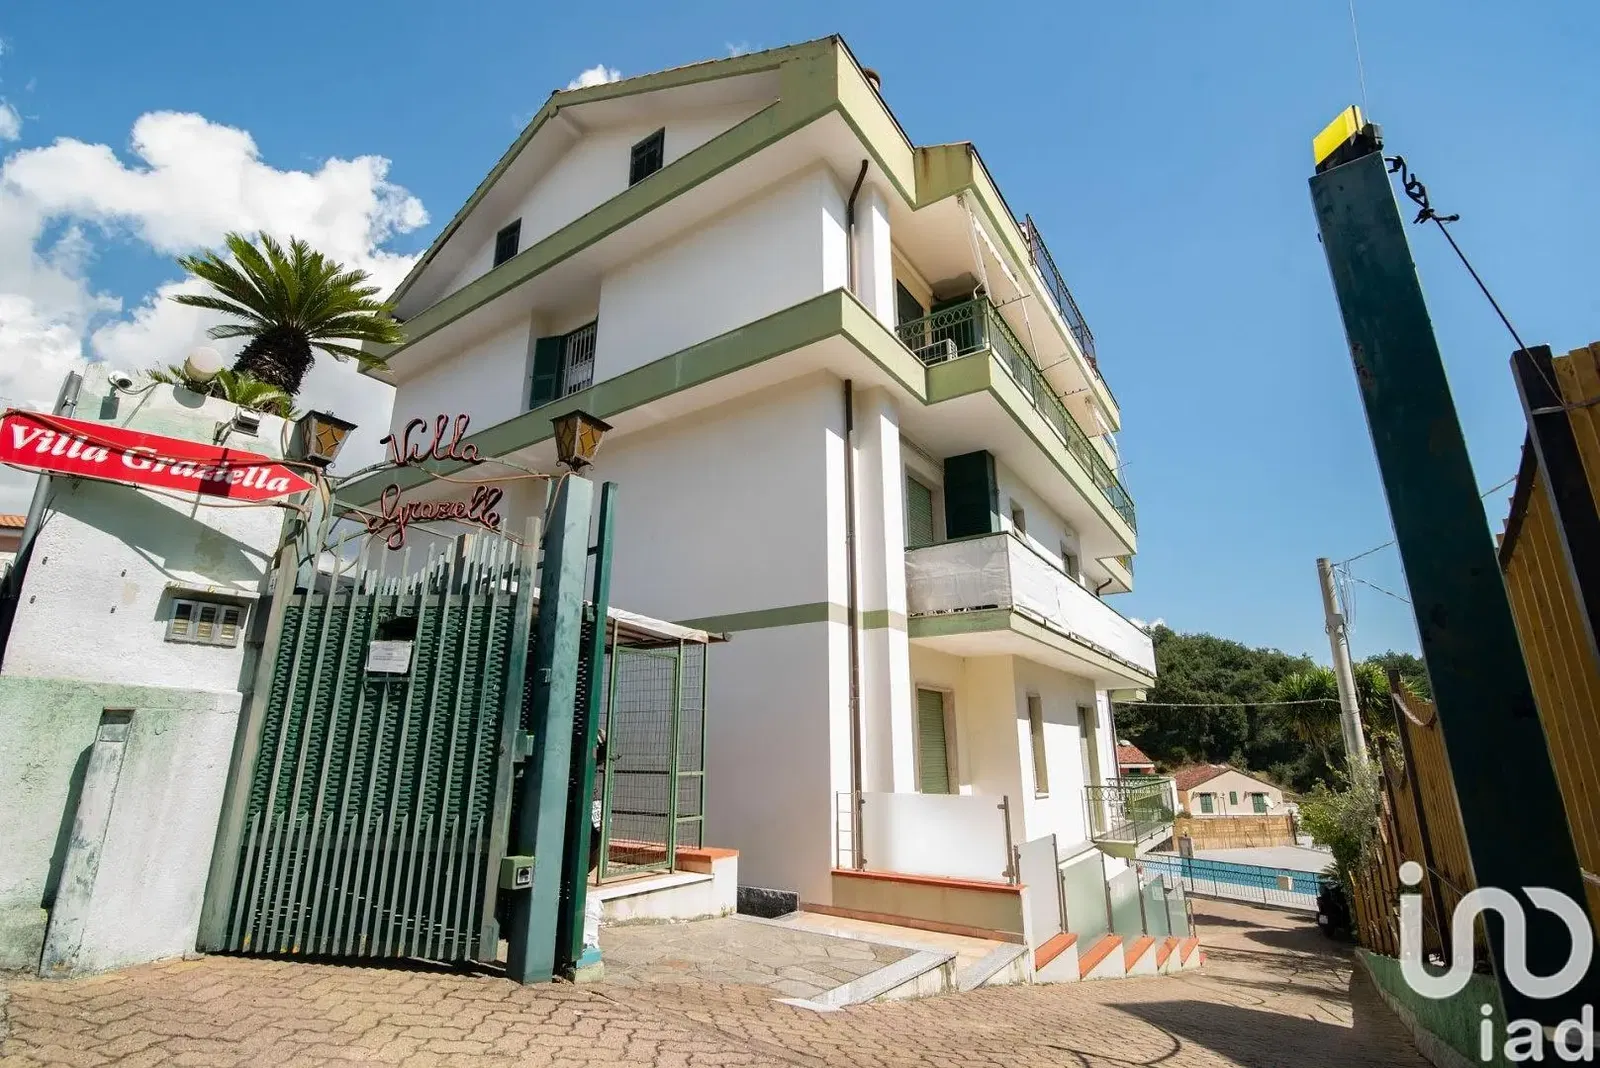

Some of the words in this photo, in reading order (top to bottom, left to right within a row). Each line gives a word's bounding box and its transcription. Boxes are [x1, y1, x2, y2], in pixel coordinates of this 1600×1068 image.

[10, 423, 110, 464] Villa
[120, 445, 291, 494] Graziella
[380, 413, 486, 467] Villa
